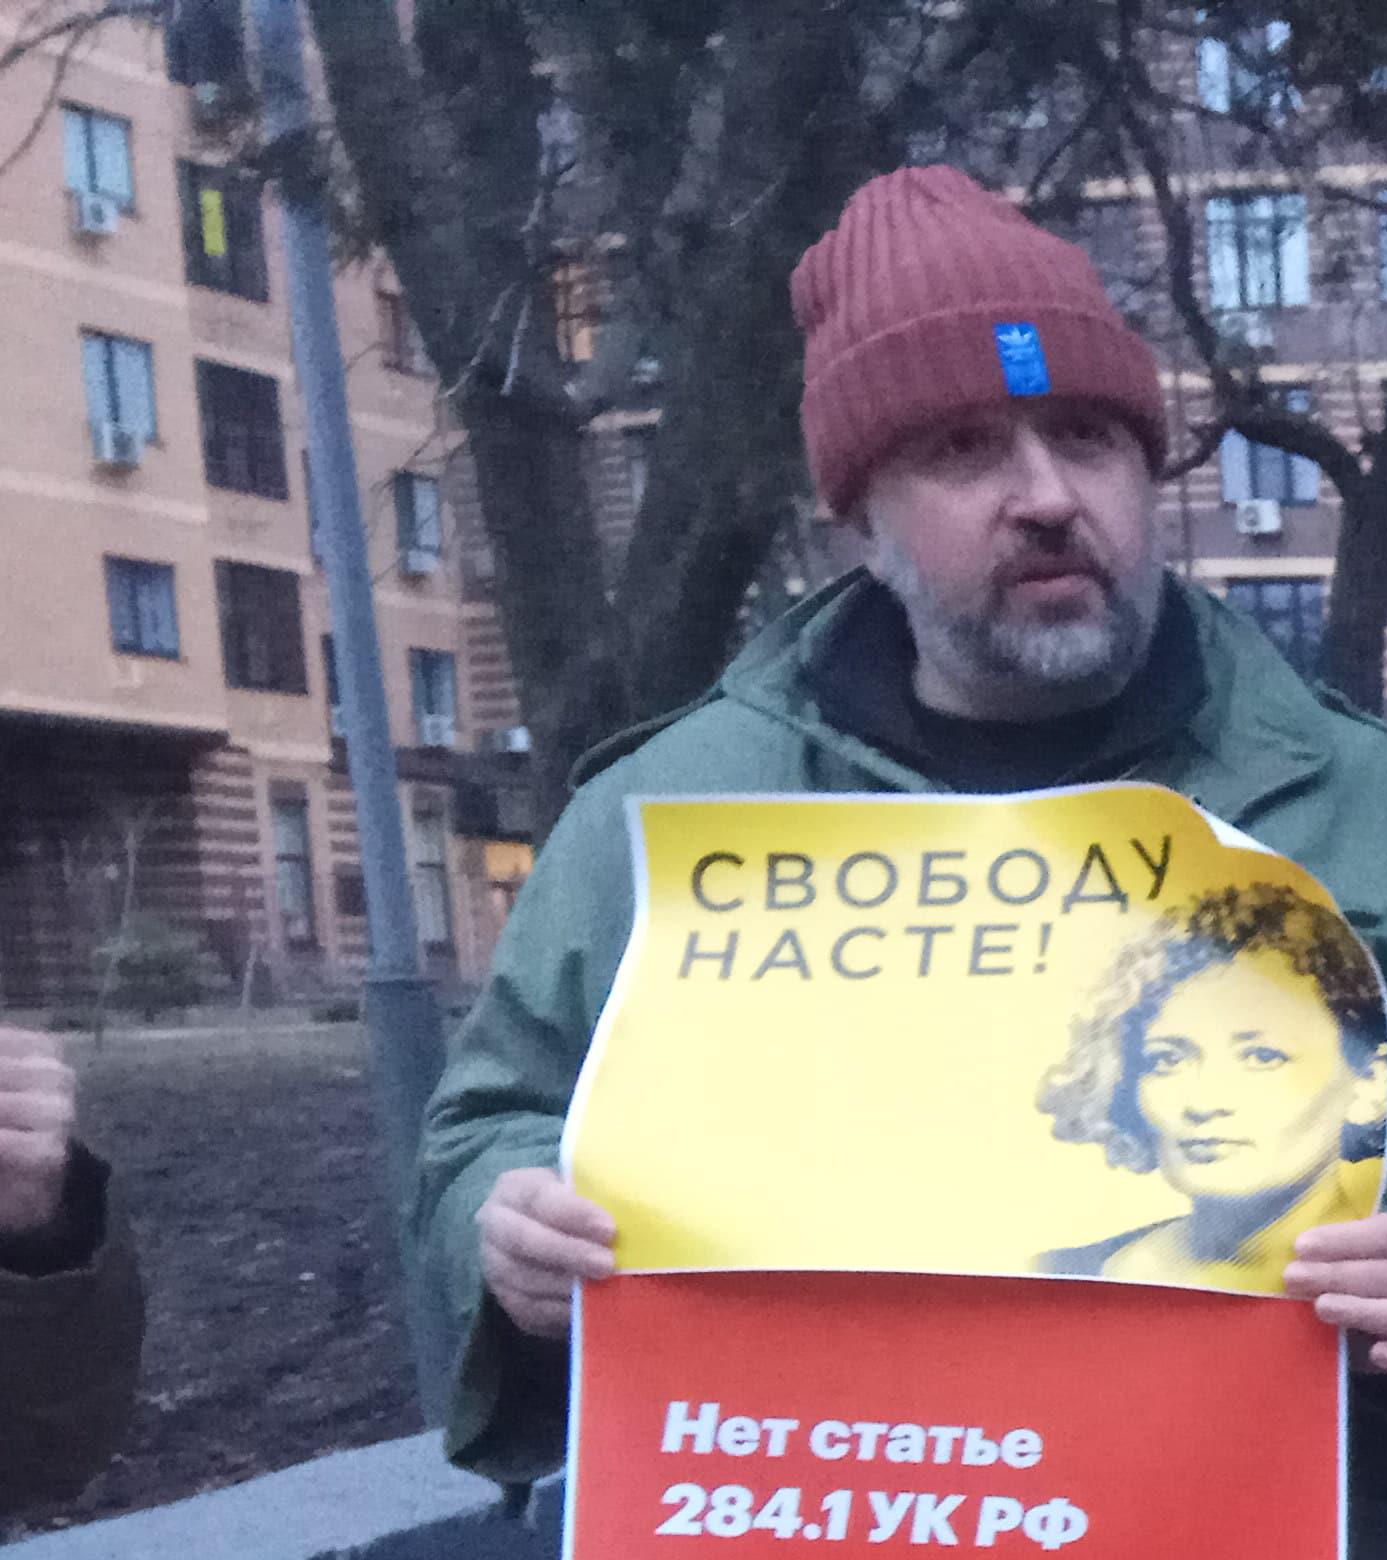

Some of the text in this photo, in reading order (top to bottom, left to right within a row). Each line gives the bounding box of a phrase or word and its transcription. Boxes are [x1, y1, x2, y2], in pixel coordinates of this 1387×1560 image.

[690, 835, 1173, 913] СВОБОДУ
[676, 922, 1054, 982] НАСТЕ!
[660, 1400, 1044, 1469] Нет статье
[654, 1482, 1089, 1550] 284.1 УК РФ
